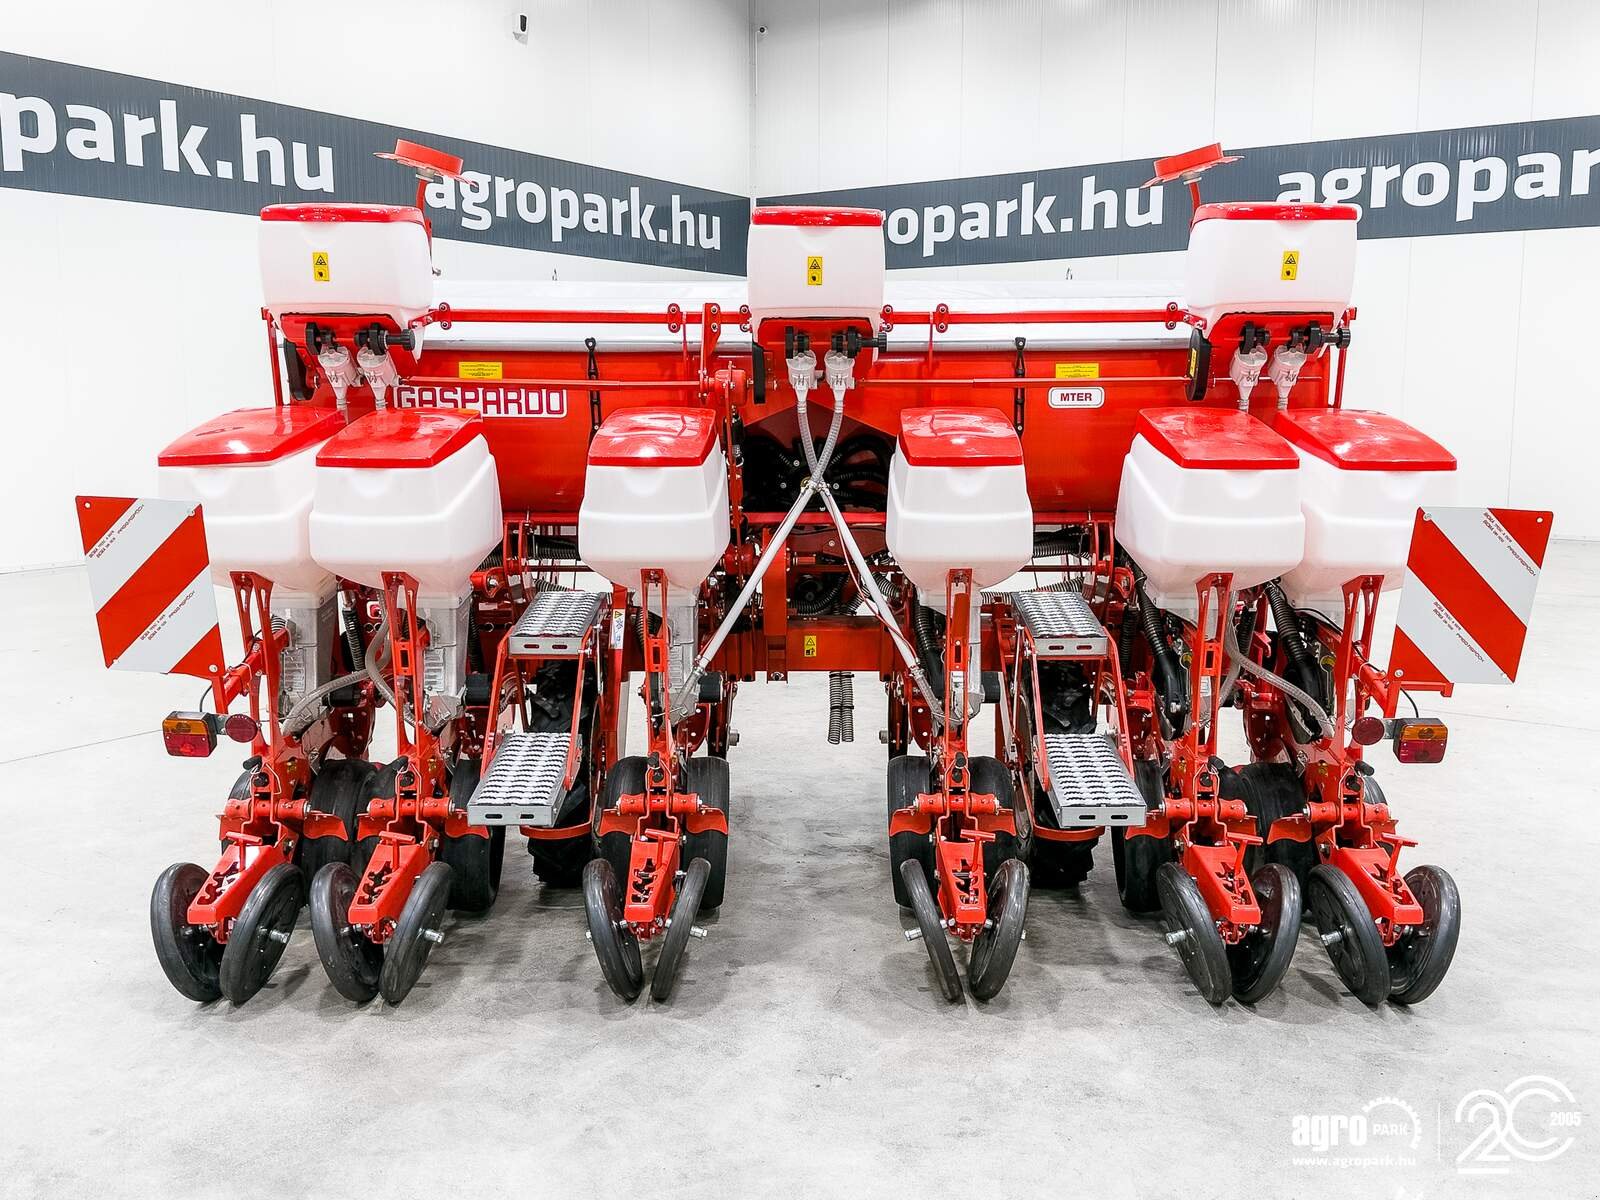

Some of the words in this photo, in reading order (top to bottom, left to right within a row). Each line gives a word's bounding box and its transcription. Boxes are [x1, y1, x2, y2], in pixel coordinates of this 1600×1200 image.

[0, 91, 335, 192] park.hu
[424, 170, 721, 250] agropark.hu
[884, 175, 1164, 258] opark.hu
[397, 387, 564, 415] GASPARDO
[1060, 393, 1093, 402] MTER
